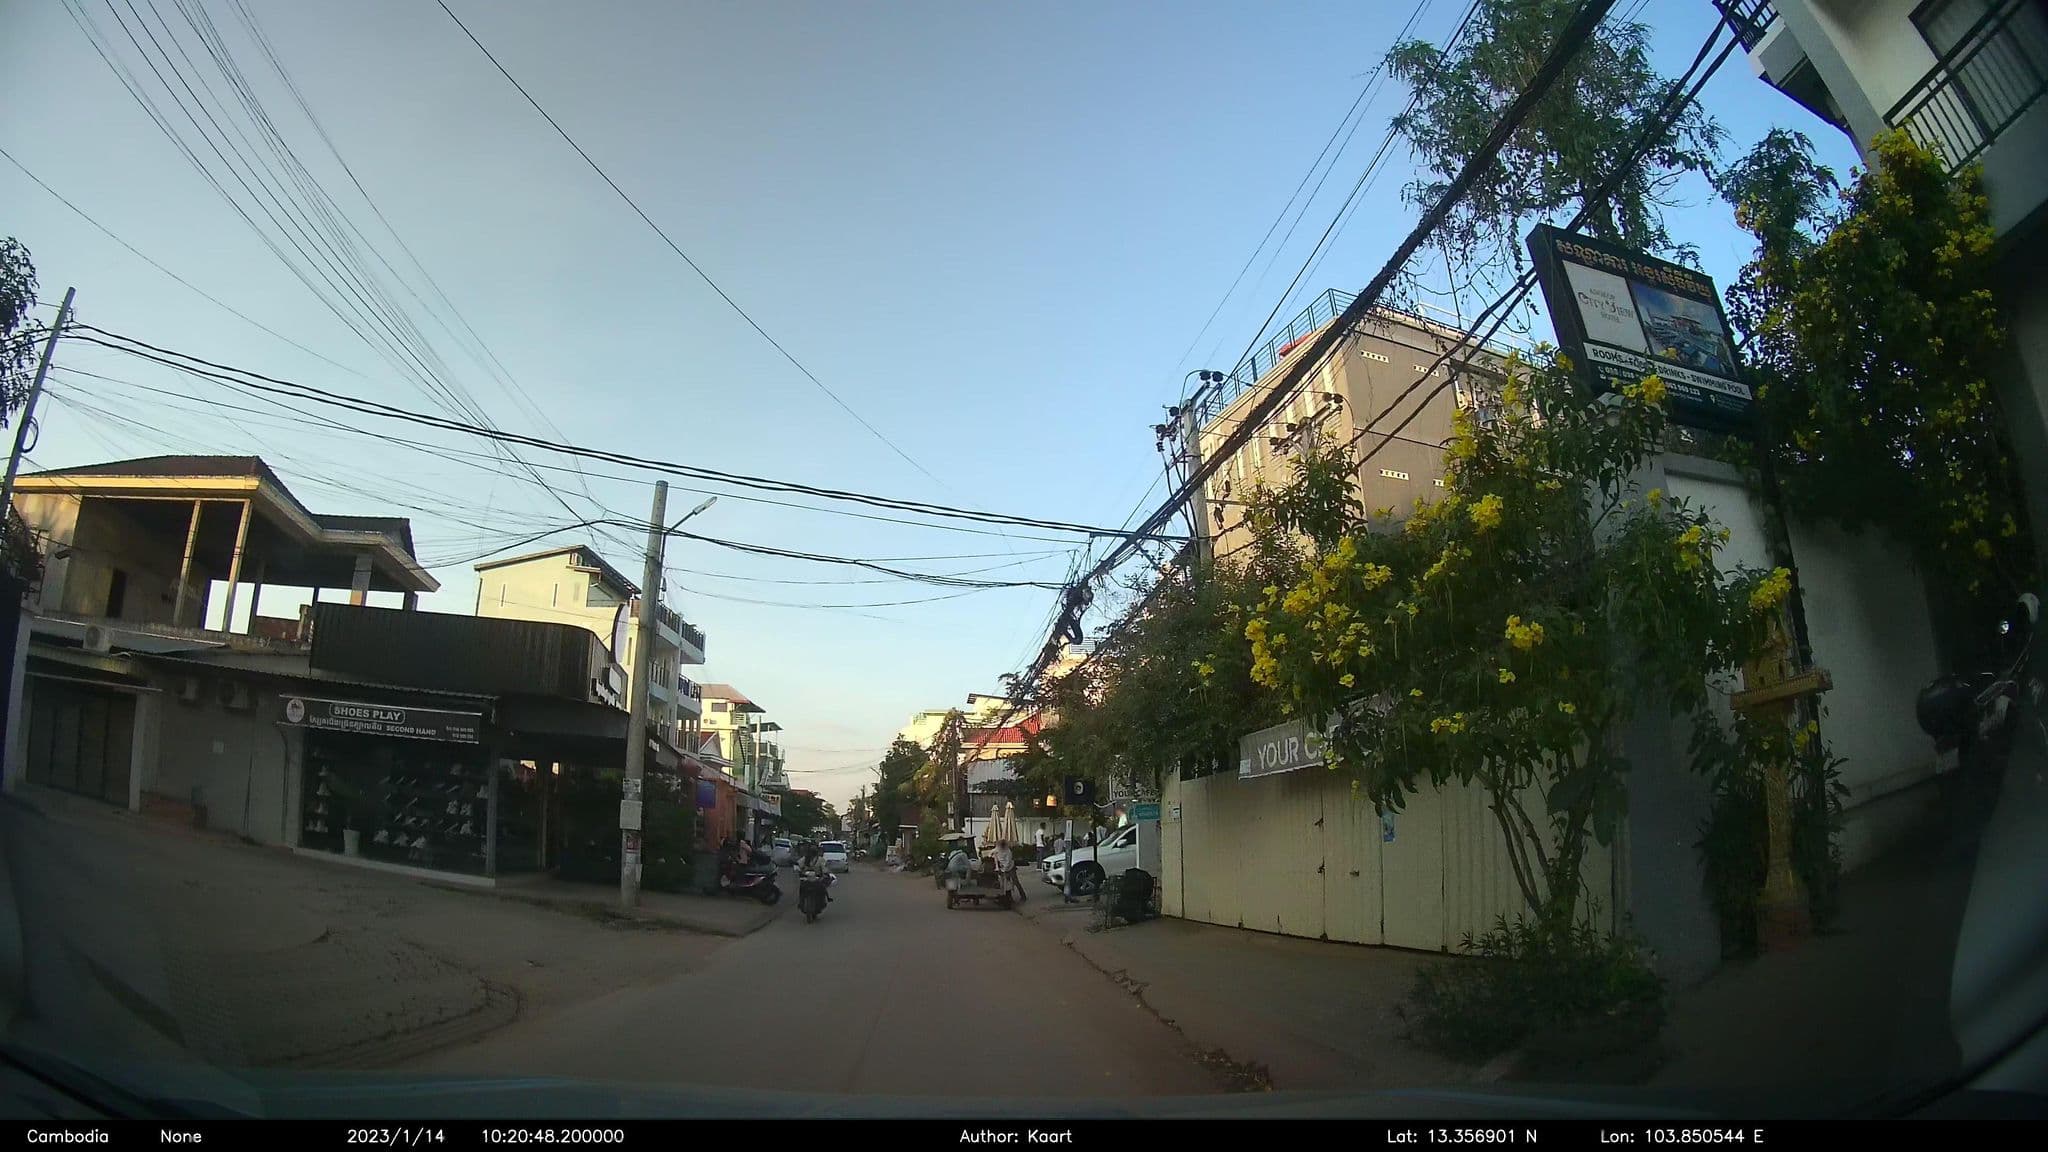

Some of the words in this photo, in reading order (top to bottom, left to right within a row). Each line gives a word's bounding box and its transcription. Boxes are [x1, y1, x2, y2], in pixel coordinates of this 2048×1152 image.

[334, 705, 370, 718] SHOES
[372, 709, 402, 721] PLAY
[386, 724, 415, 735] SECOND
[416, 728, 437, 736] HAND
[1257, 736, 1299, 770] YOUR
